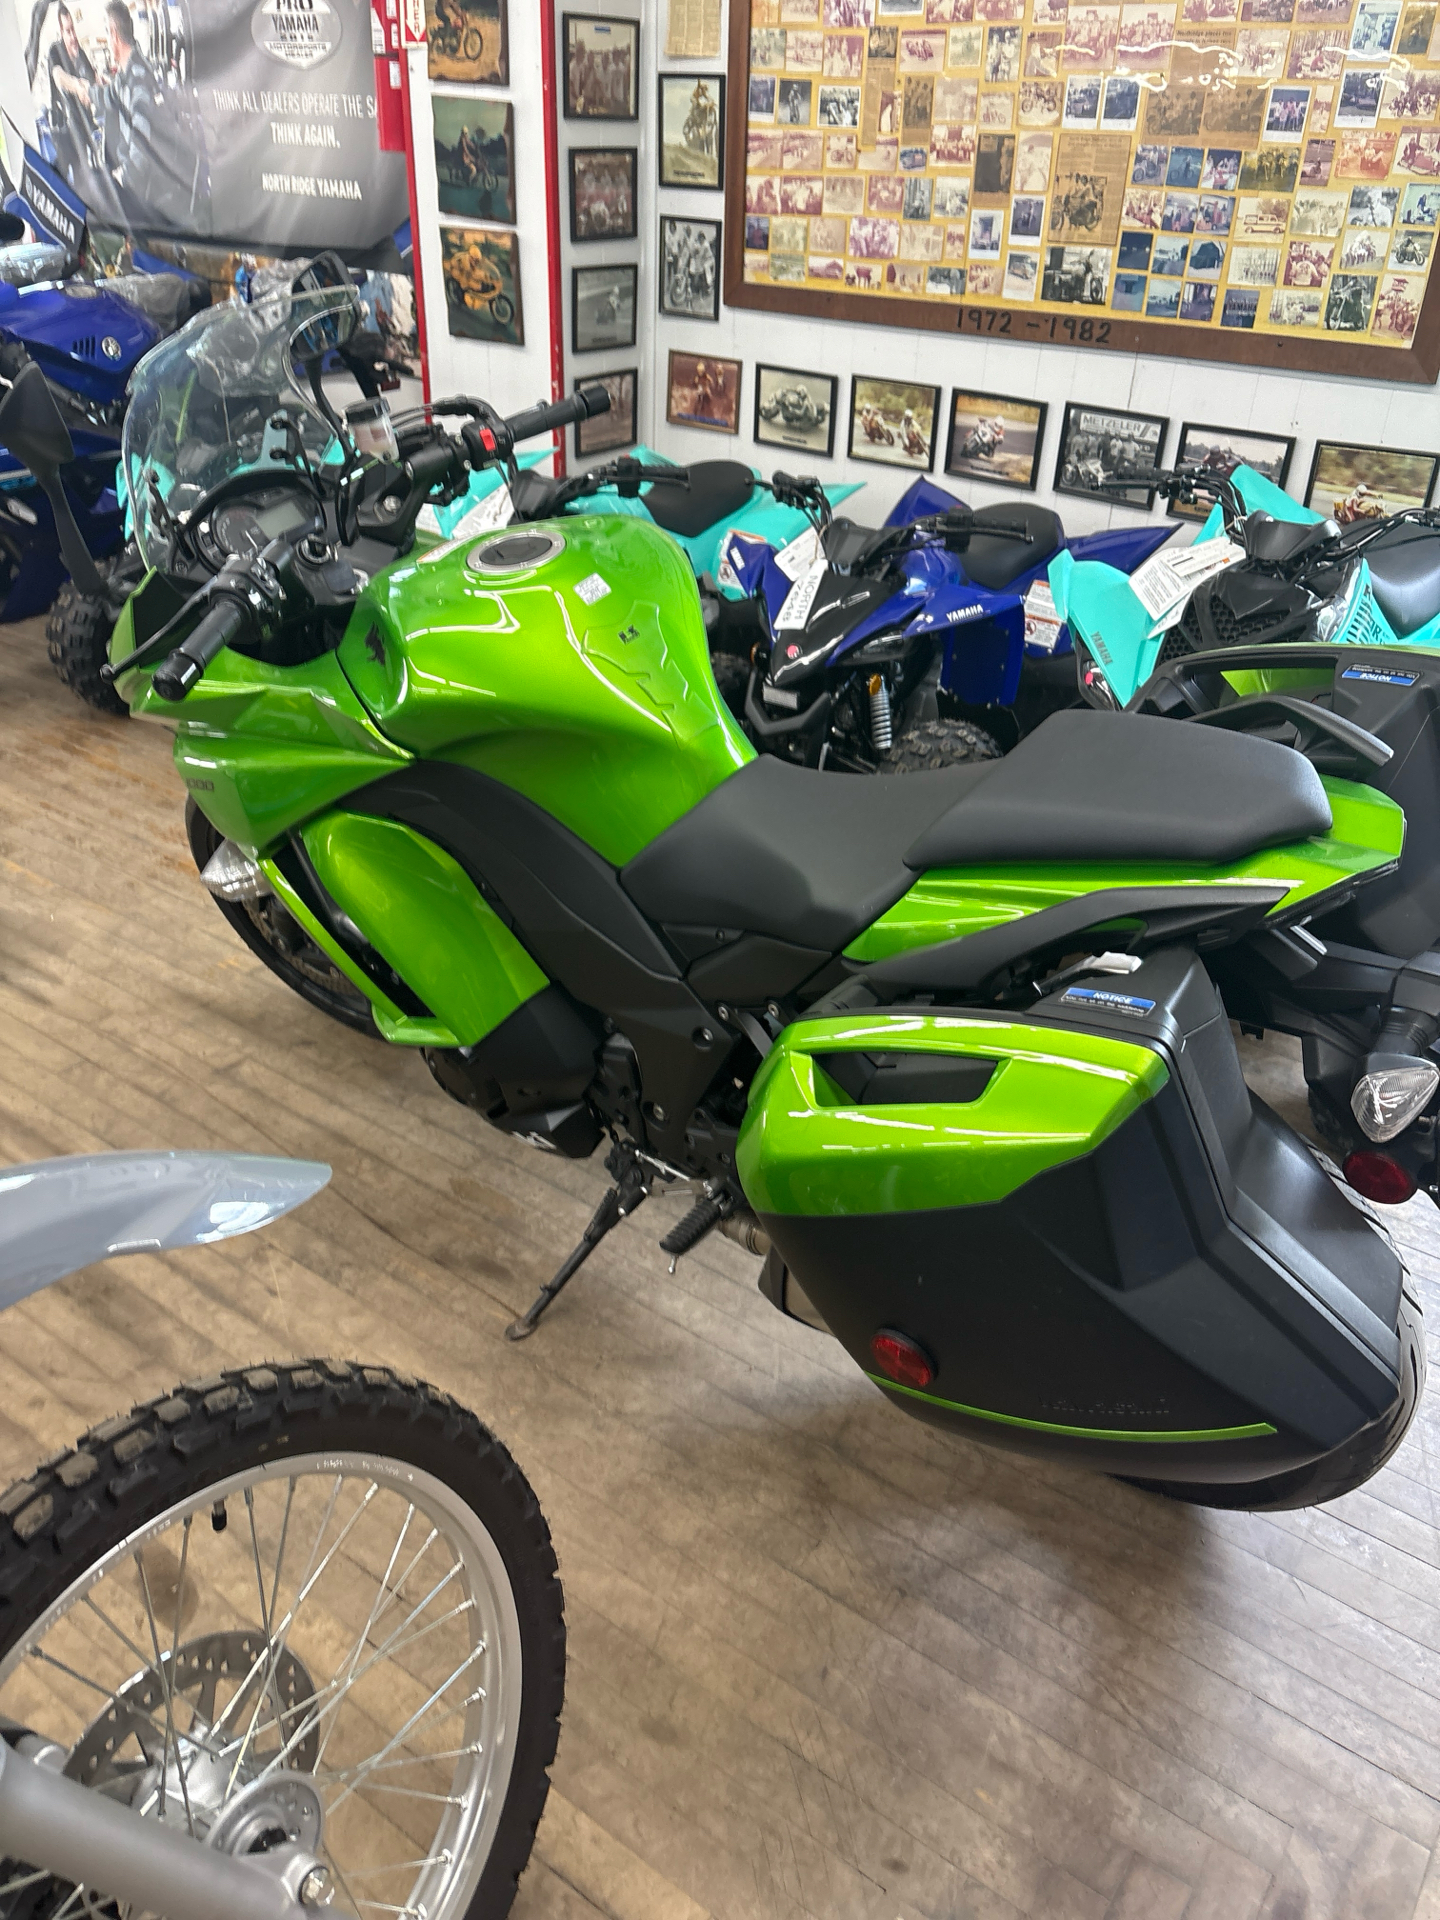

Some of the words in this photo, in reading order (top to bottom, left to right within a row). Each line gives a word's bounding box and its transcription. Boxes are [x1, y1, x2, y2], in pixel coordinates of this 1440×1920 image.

[276, 0, 314, 12] PRO
[271, 13, 319, 33] YAMAHA
[269, 42, 327, 51] MOTORSPORTS
[212, 89, 242, 112] THINK
[242, 90, 260, 113] ALL
[260, 91, 300, 115] DEALERS
[301, 92, 340, 118] OPERATE
[341, 93, 364, 119] THE
[270, 121, 303, 146] THINK
[304, 124, 341, 148] AGAIN.
[262, 173, 291, 194] NORTH
[290, 175, 317, 197] RIDGE
[316, 178, 363, 201] YAMAHA
[33, 184, 75, 244] YAMAHA
[957, 307, 1013, 334] 1972
[1050, 316, 1112, 344] 1982
[1082, 414, 1141, 432] METZELER
[794, 574, 819, 620] NORTH
[946, 603, 984, 623] YAMAHA
[1090, 631, 1114, 665] YAMAHA
[1093, 992, 1134, 1004] NOTICE
